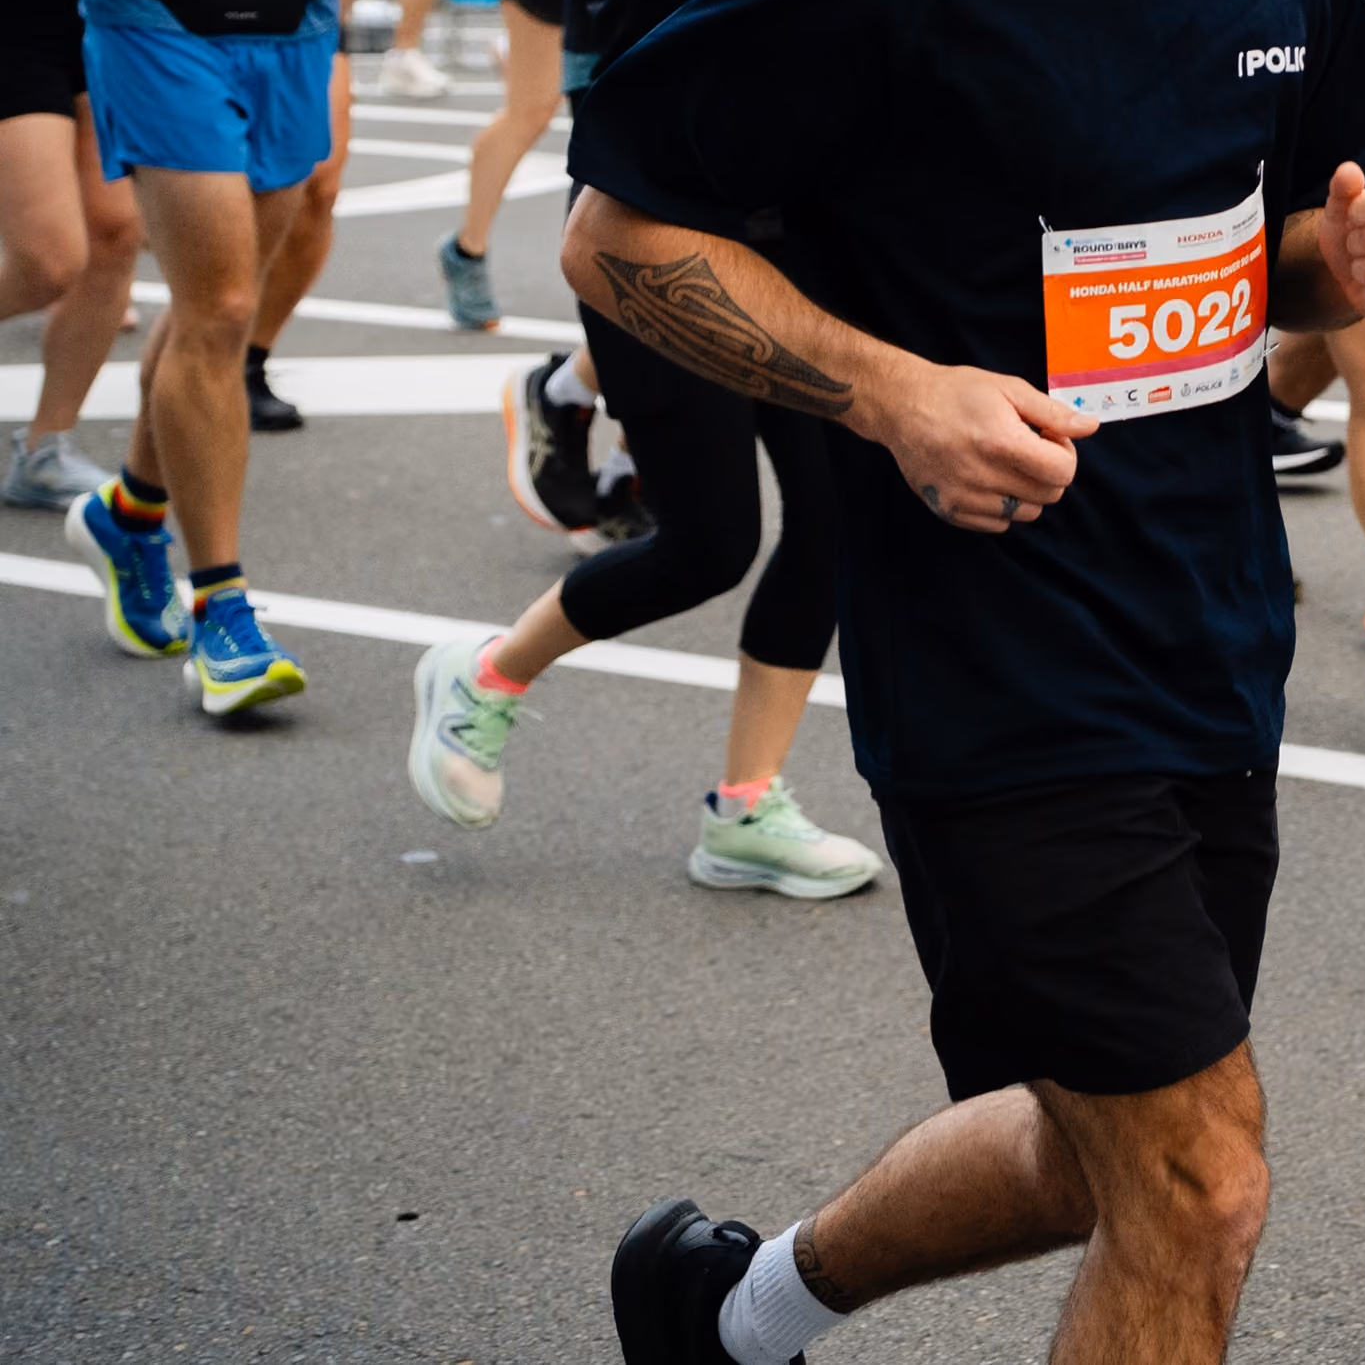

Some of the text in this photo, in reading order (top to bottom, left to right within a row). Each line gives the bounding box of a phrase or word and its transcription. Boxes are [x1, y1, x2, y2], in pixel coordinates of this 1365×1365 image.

[1177, 229, 1223, 244] HONDA
[1073, 243, 1114, 254] ROUND
[1117, 240, 1147, 250] BAYS
[1069, 283, 1117, 299] HONDA
[1118, 280, 1151, 294] HALF
[1153, 269, 1219, 290] MARATHON
[1108, 278, 1252, 360] 5022
[1195, 380, 1223, 394] POLICE
